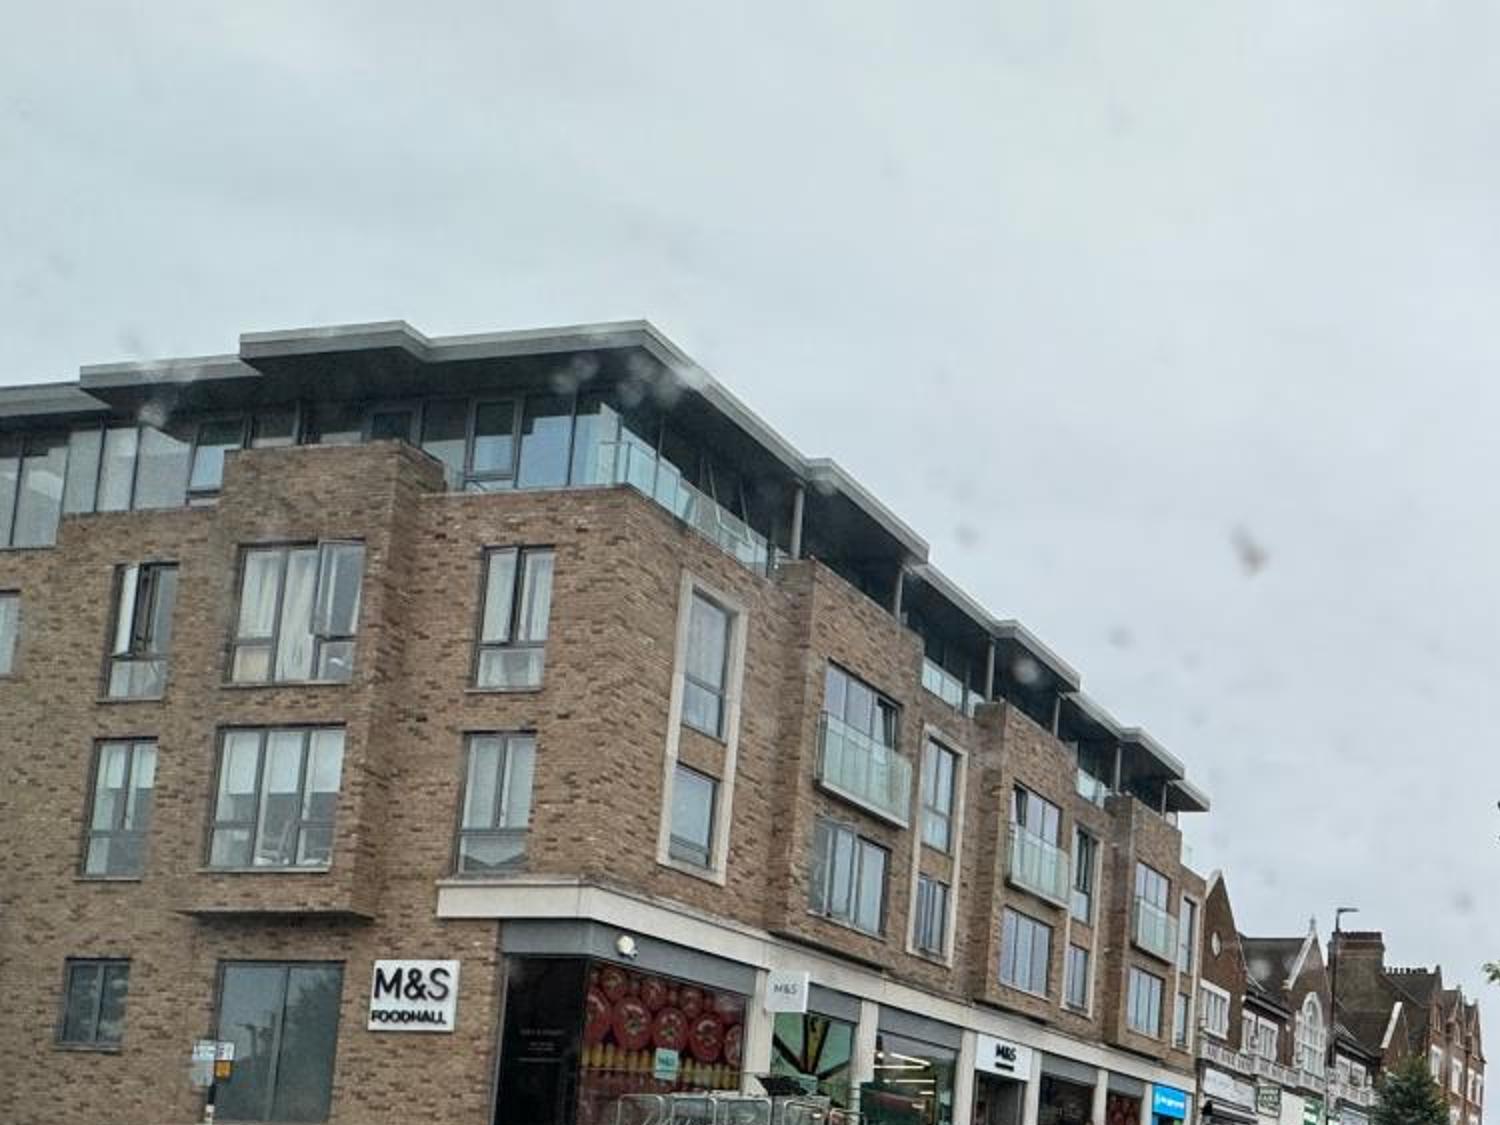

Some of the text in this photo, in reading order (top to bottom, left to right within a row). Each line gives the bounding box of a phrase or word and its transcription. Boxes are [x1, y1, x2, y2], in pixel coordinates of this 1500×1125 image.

[374, 967, 450, 1001] M&S
[773, 983, 798, 995] M&S
[371, 1010, 447, 1025] FOODHALL
[995, 1043, 1017, 1062] M&S
